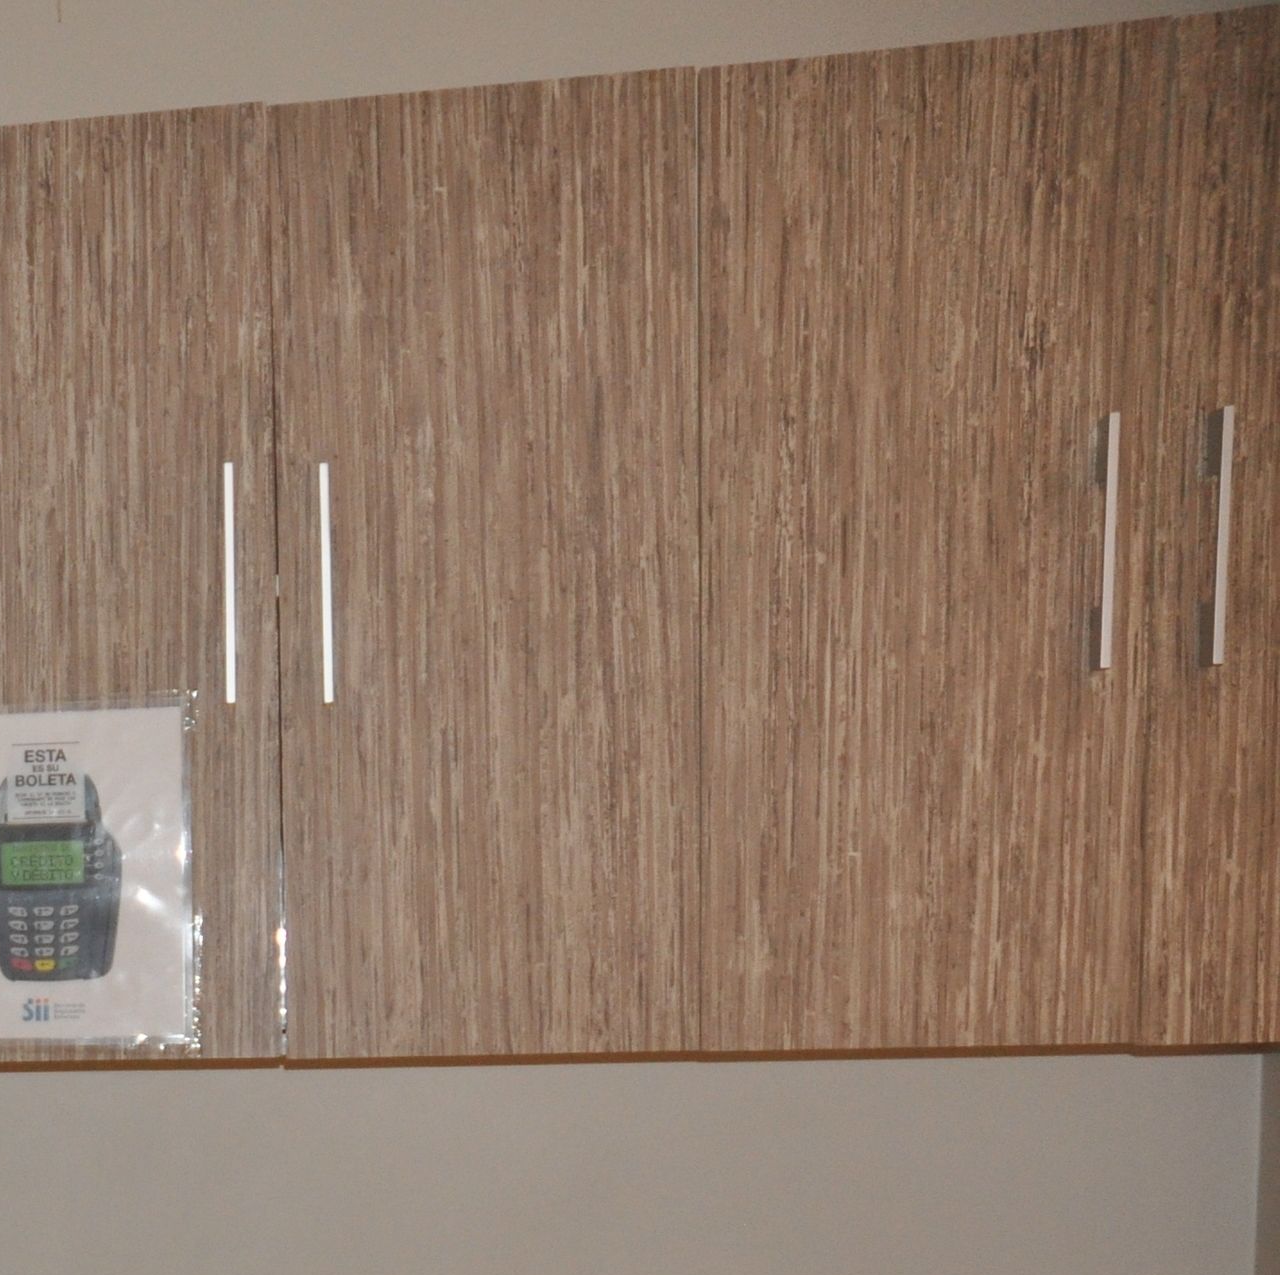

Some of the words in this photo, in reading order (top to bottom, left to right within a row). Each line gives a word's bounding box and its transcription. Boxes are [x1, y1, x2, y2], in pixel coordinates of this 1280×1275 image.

[24, 749, 67, 763] ESTA
[32, 764, 45, 773] ES
[46, 764, 60, 772] SU
[15, 772, 77, 787] BOLETA
